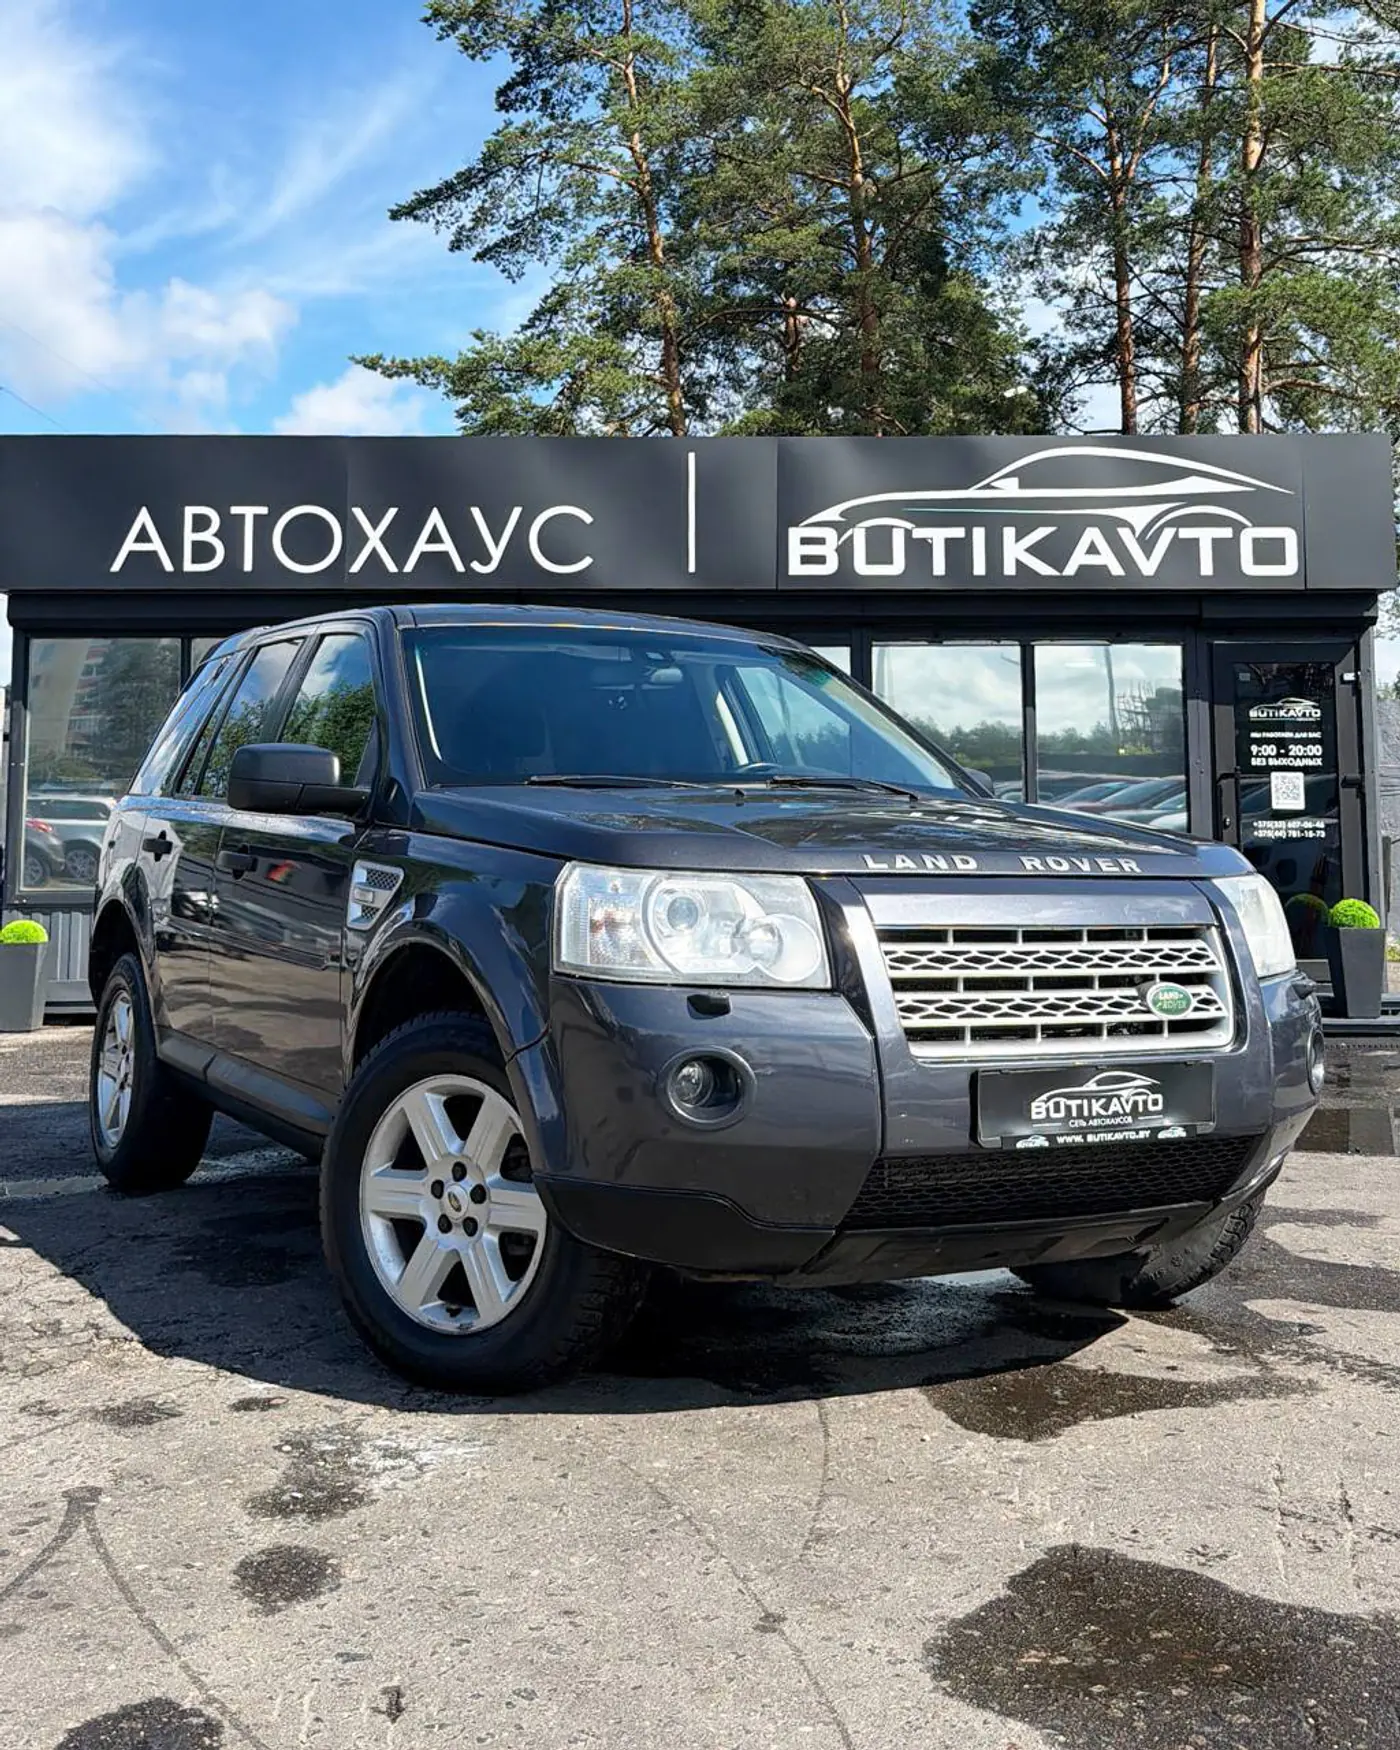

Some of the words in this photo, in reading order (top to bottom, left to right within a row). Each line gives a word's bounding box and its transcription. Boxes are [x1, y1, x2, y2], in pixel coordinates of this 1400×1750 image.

[110, 504, 595, 575] АВТОХАУС
[787, 525, 1299, 577] BUTIKAVTO
[1249, 708, 1321, 718] BUTIKAVTO
[1250, 744, 1277, 756] 9:00
[1288, 744, 1323, 756] 20:00
[1251, 757, 1267, 766] БЕЗ
[1268, 757, 1323, 767] ВЫХОДНЫХ
[864, 853, 978, 871] LAND
[1021, 855, 1143, 873] ROVER
[1159, 991, 1179, 1000] LAND
[1031, 1093, 1164, 1120] BUTIKAVTO
